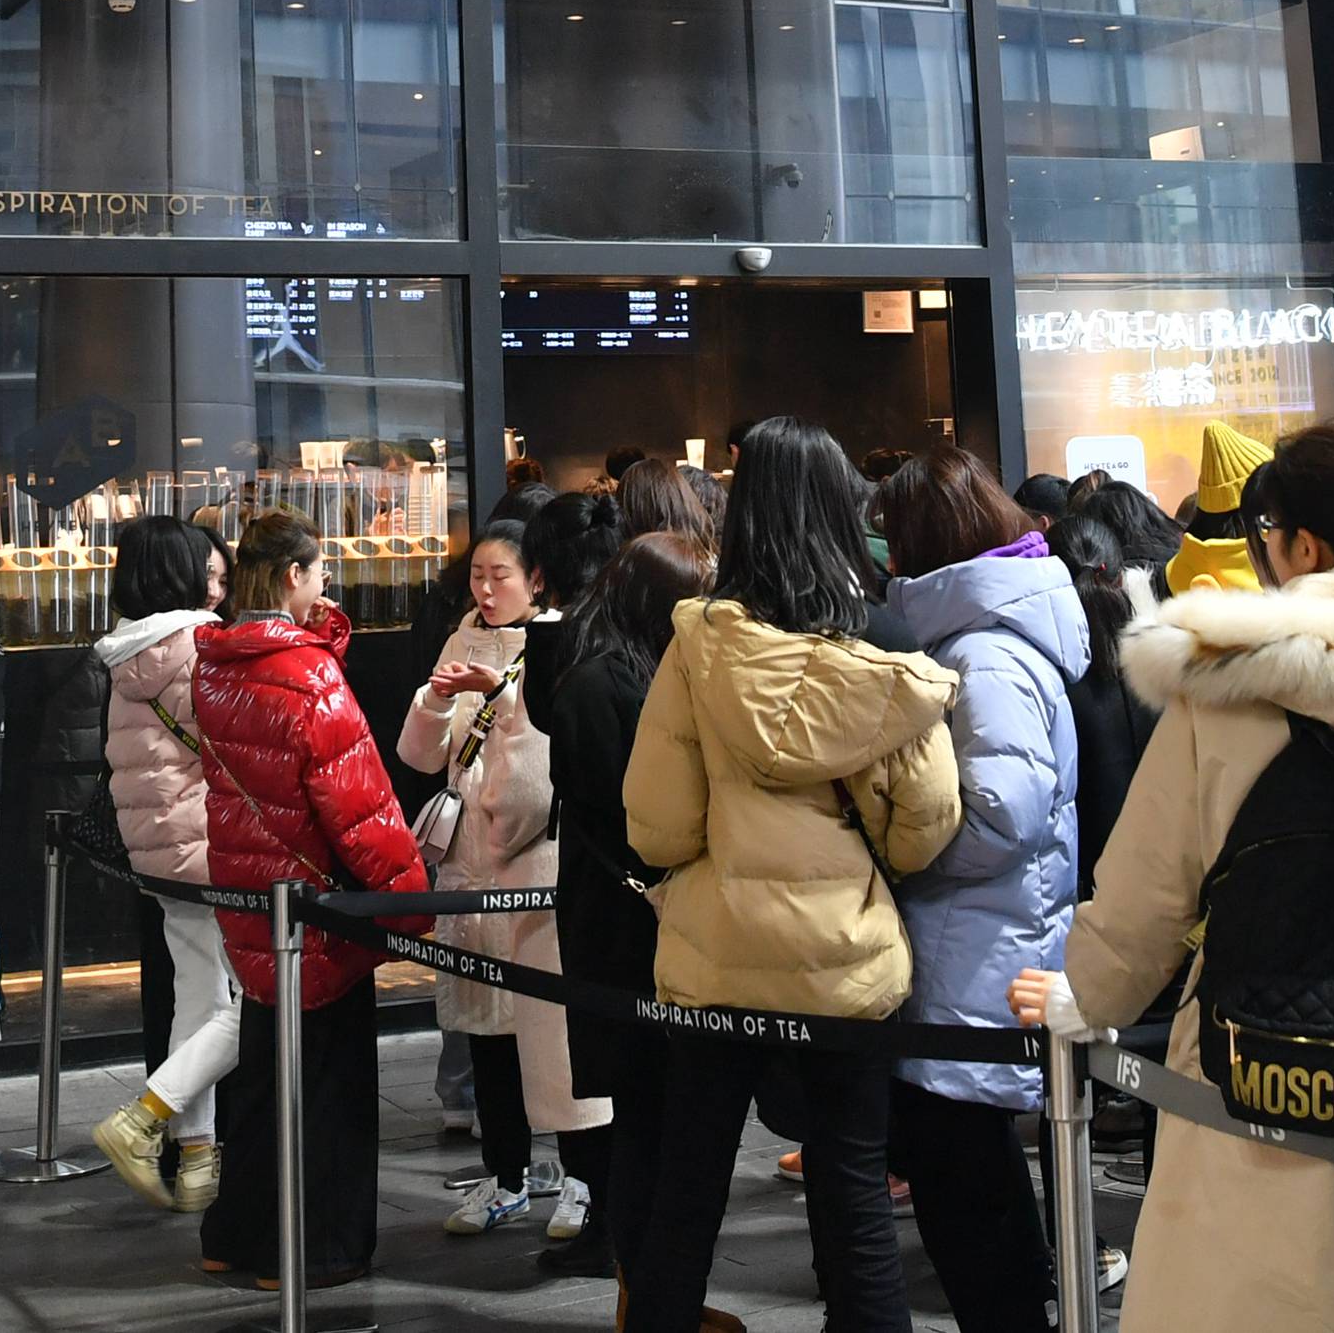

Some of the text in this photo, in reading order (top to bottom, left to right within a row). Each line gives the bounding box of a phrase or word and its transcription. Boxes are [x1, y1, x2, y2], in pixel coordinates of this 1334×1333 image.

[168, 195, 206, 217] OF
[224, 196, 275, 218] TEA
[247, 894, 258, 909] OF
[483, 891, 557, 909] INSPIRA
[387, 932, 503, 983] INSPIRATION OF TEA
[637, 998, 811, 1042] INSPIRATION OF TEA
[1116, 1053, 1141, 1089] IFS
